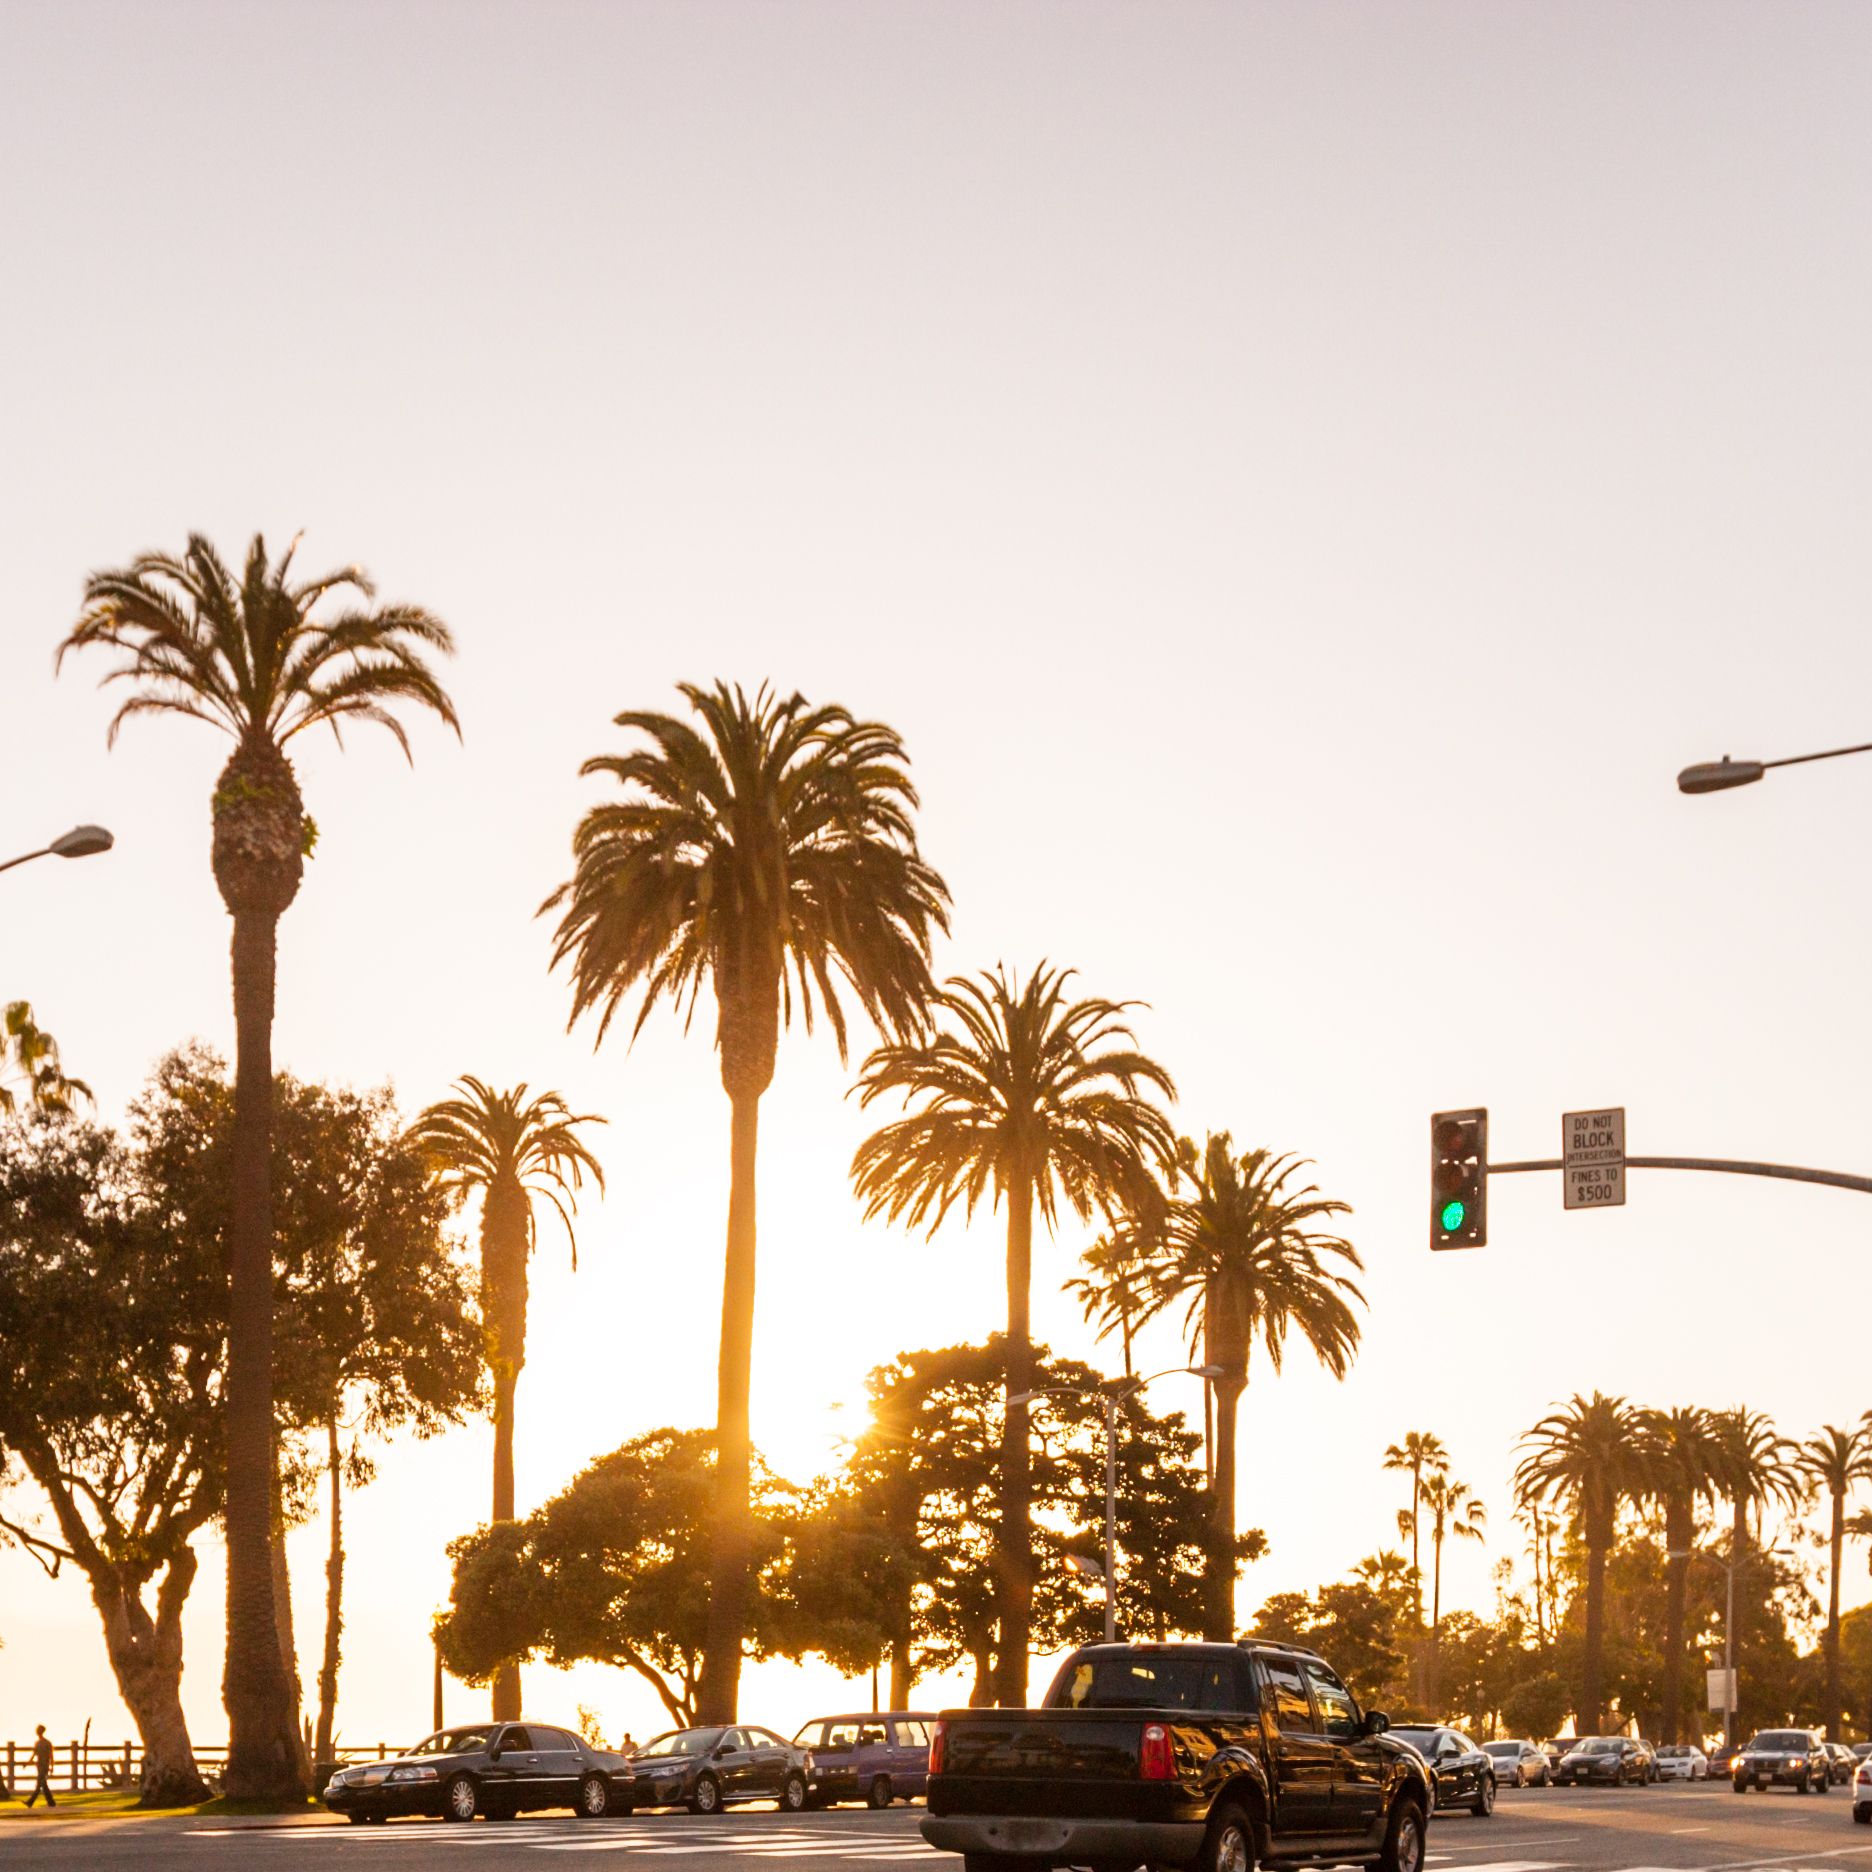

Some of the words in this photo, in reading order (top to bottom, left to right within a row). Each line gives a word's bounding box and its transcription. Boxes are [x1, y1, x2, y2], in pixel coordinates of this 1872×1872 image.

[1574, 1117, 1589, 1131] DO
[1593, 1115, 1612, 1129] NOT
[1573, 1131, 1615, 1149] BLOCK
[1568, 1149, 1621, 1162] INTERSECTION
[1571, 1169, 1601, 1184] FINES
[1605, 1168, 1618, 1181] TO
[1577, 1184, 1612, 1202] $500
